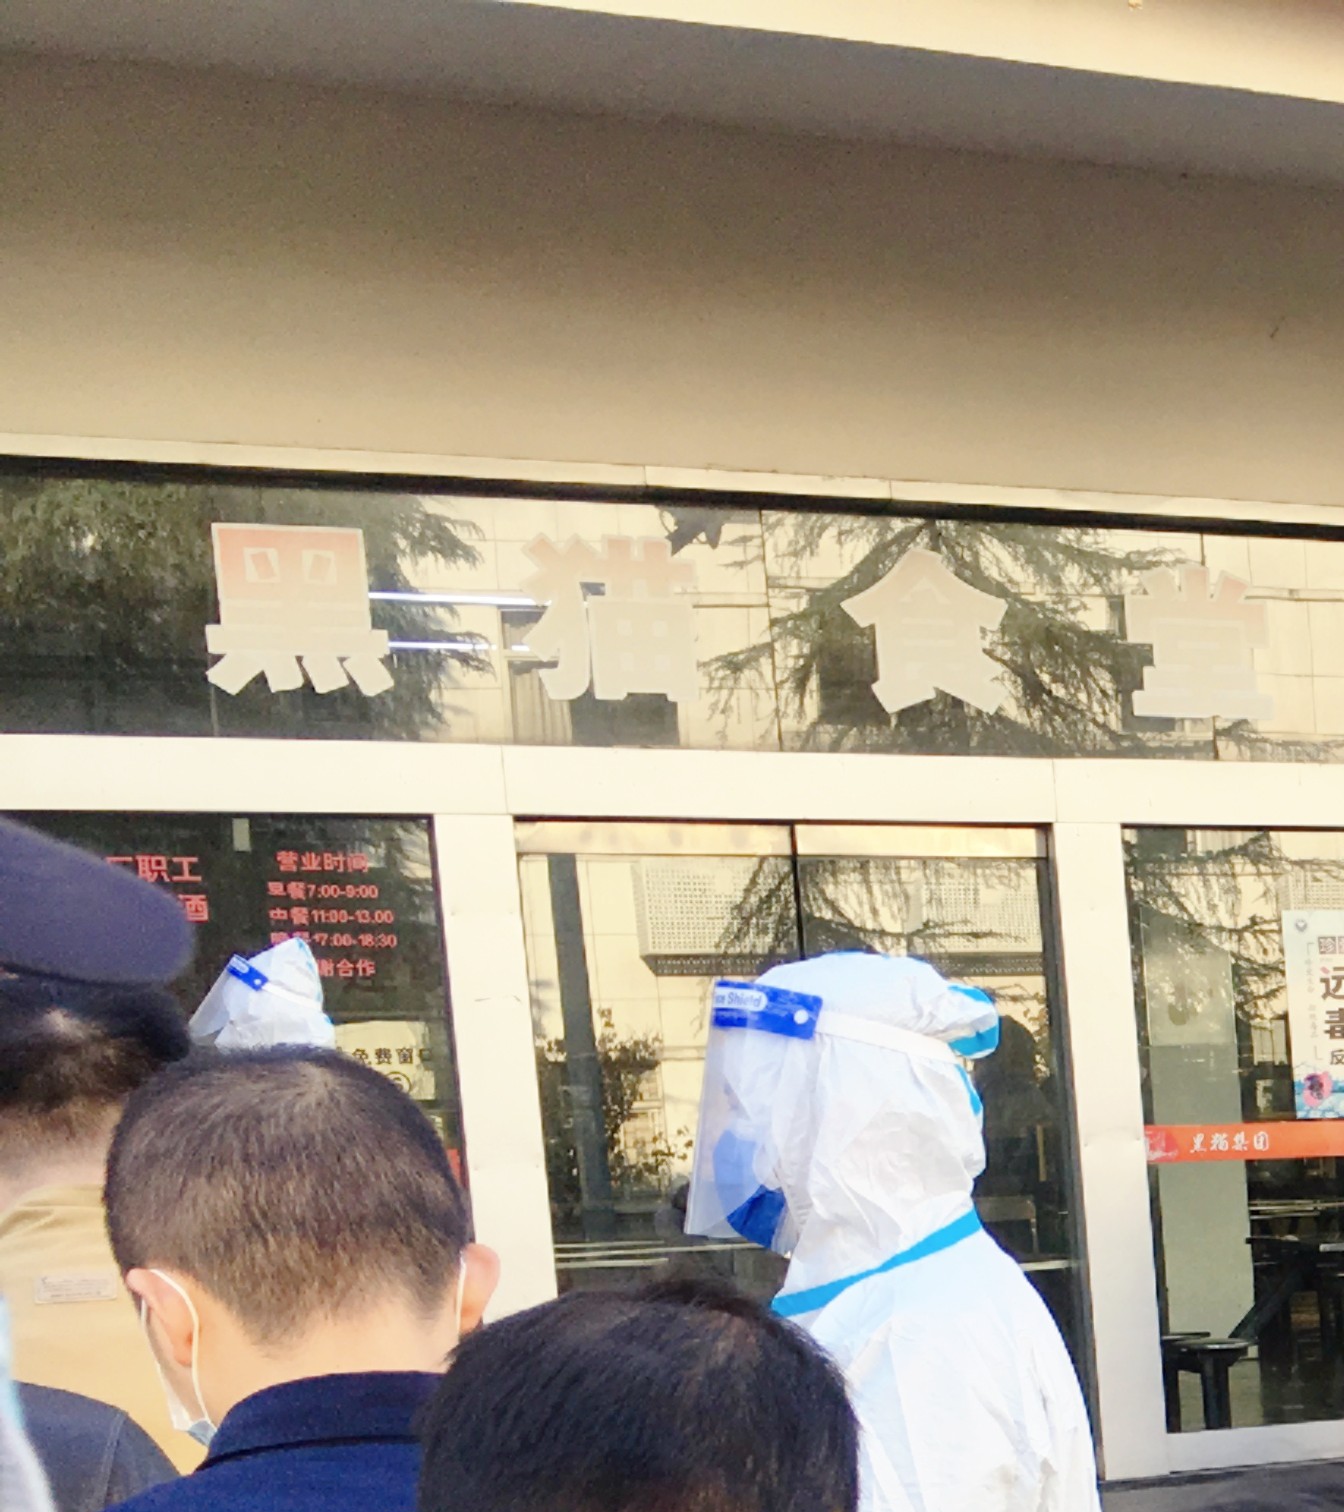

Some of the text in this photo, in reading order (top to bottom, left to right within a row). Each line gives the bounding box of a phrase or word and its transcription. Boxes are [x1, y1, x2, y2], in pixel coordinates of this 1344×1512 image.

[205, 523, 1274, 719] 黑猫食堂
[276, 851, 369, 873] 营业时间
[336, 1047, 432, 1065] 免费窗口
